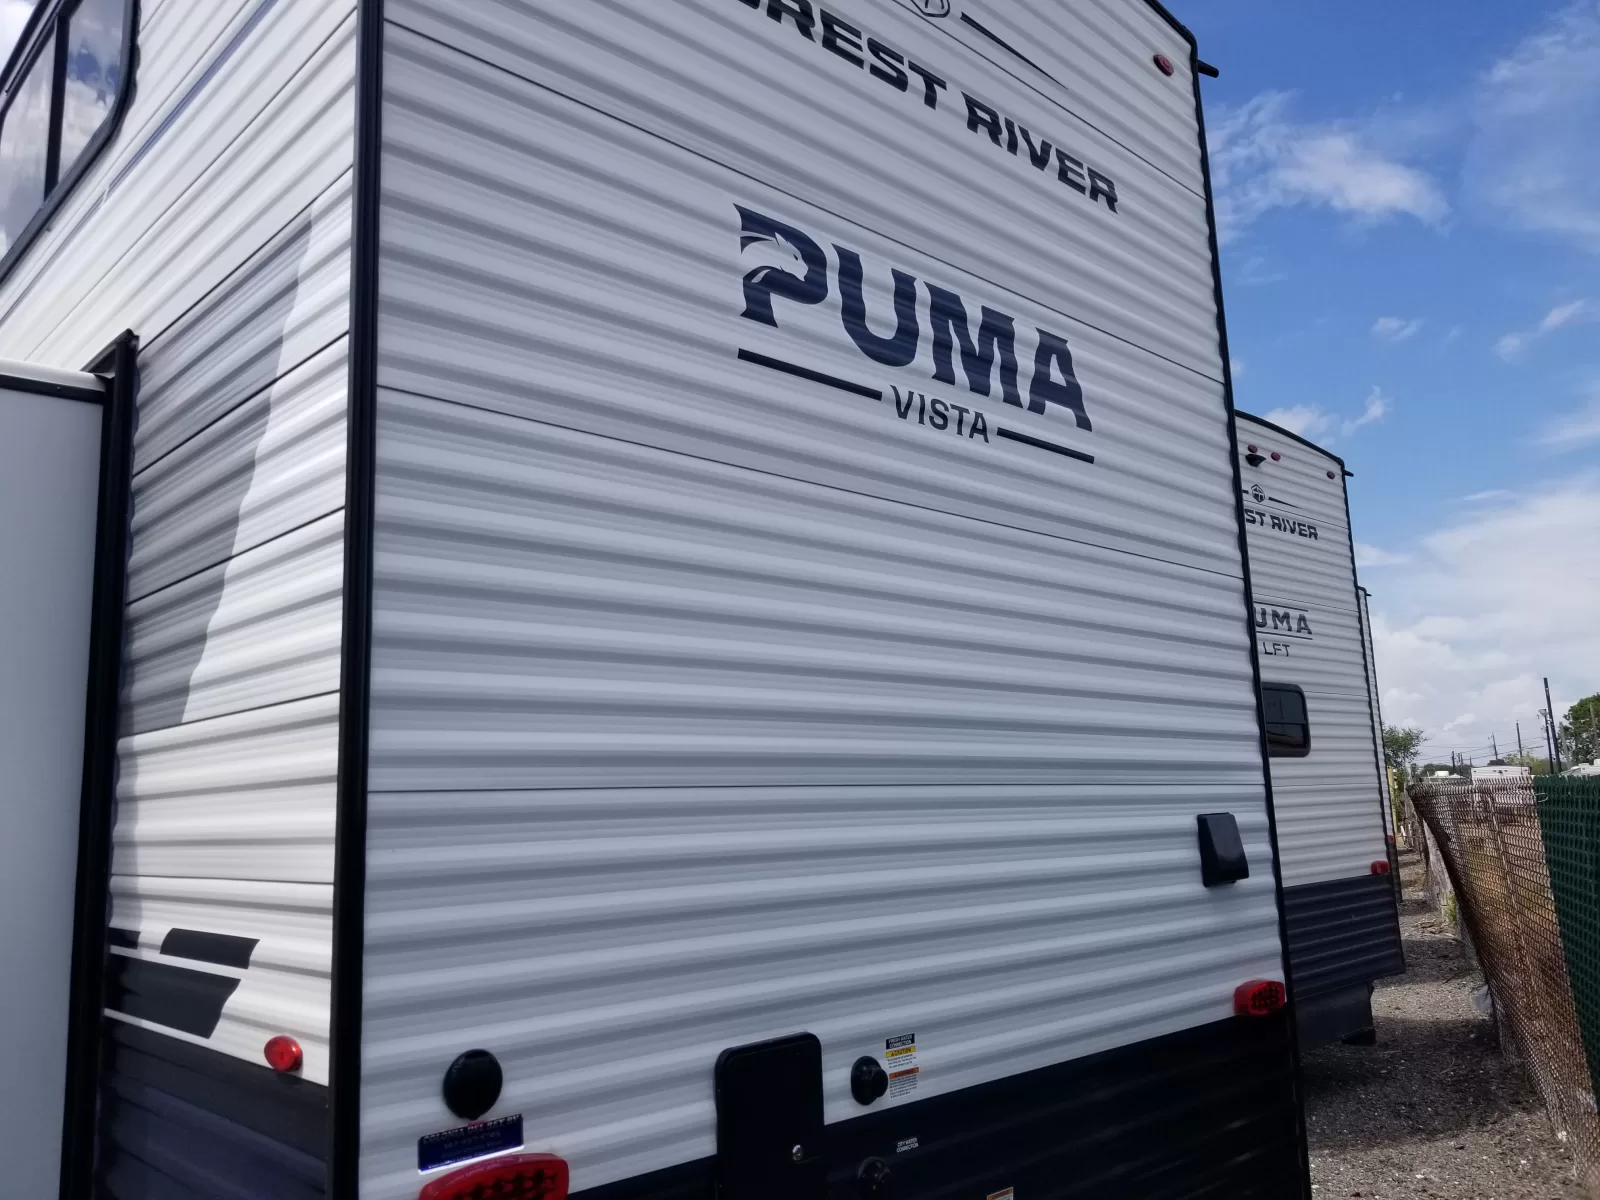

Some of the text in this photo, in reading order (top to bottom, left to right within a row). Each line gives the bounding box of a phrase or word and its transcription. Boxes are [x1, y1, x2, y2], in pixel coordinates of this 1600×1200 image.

[961, 91, 1118, 214] RIVER
[733, 203, 1093, 432] PUMA
[890, 384, 990, 443] VISTA
[1271, 514, 1319, 540] RIVER
[1263, 641, 1291, 657] LFT
